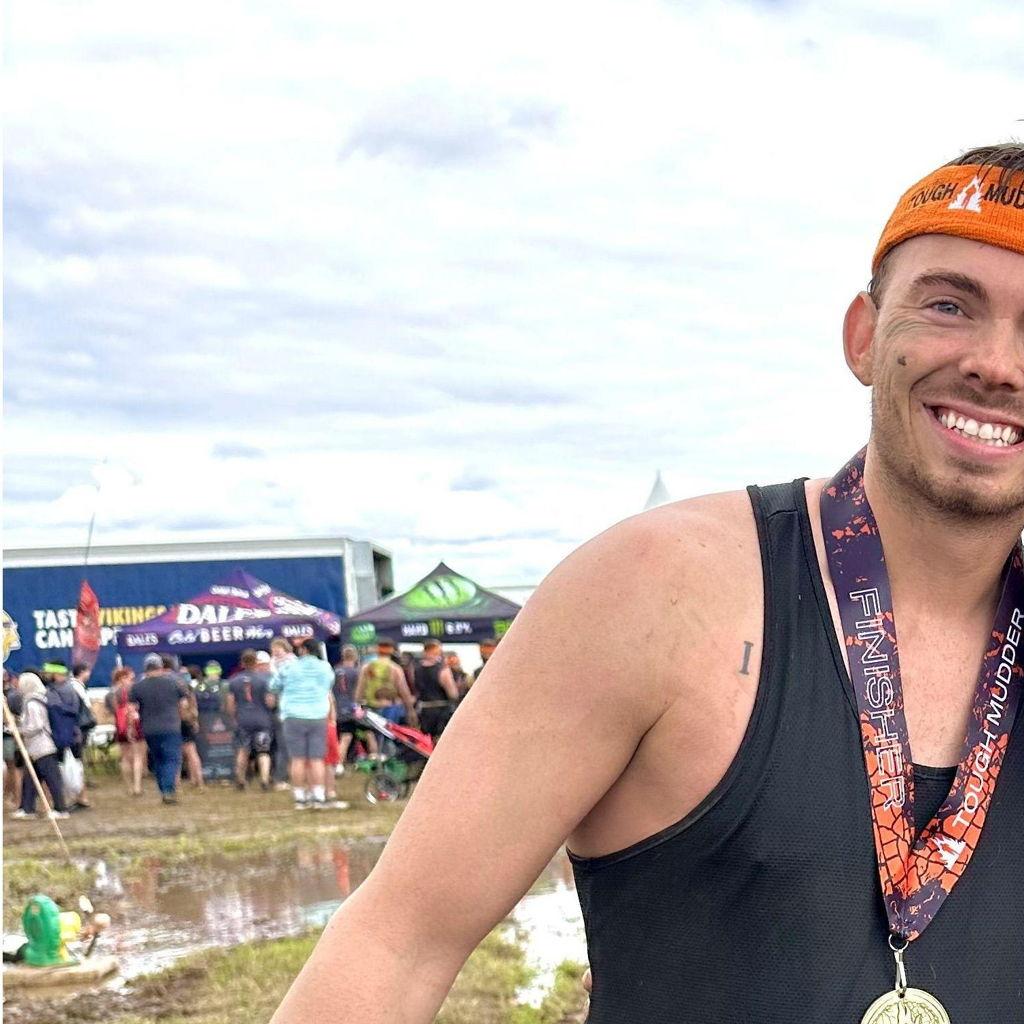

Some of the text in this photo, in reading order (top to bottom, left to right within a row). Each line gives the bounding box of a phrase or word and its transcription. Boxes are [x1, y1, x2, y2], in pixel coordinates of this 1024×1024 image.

[911, 183, 959, 208] TOUGH
[33, 609, 78, 629] TAST
[200, 627, 244, 643] BEER
[850, 587, 906, 812] FINISHER
[952, 607, 1024, 829] TOUGH MUDDER
